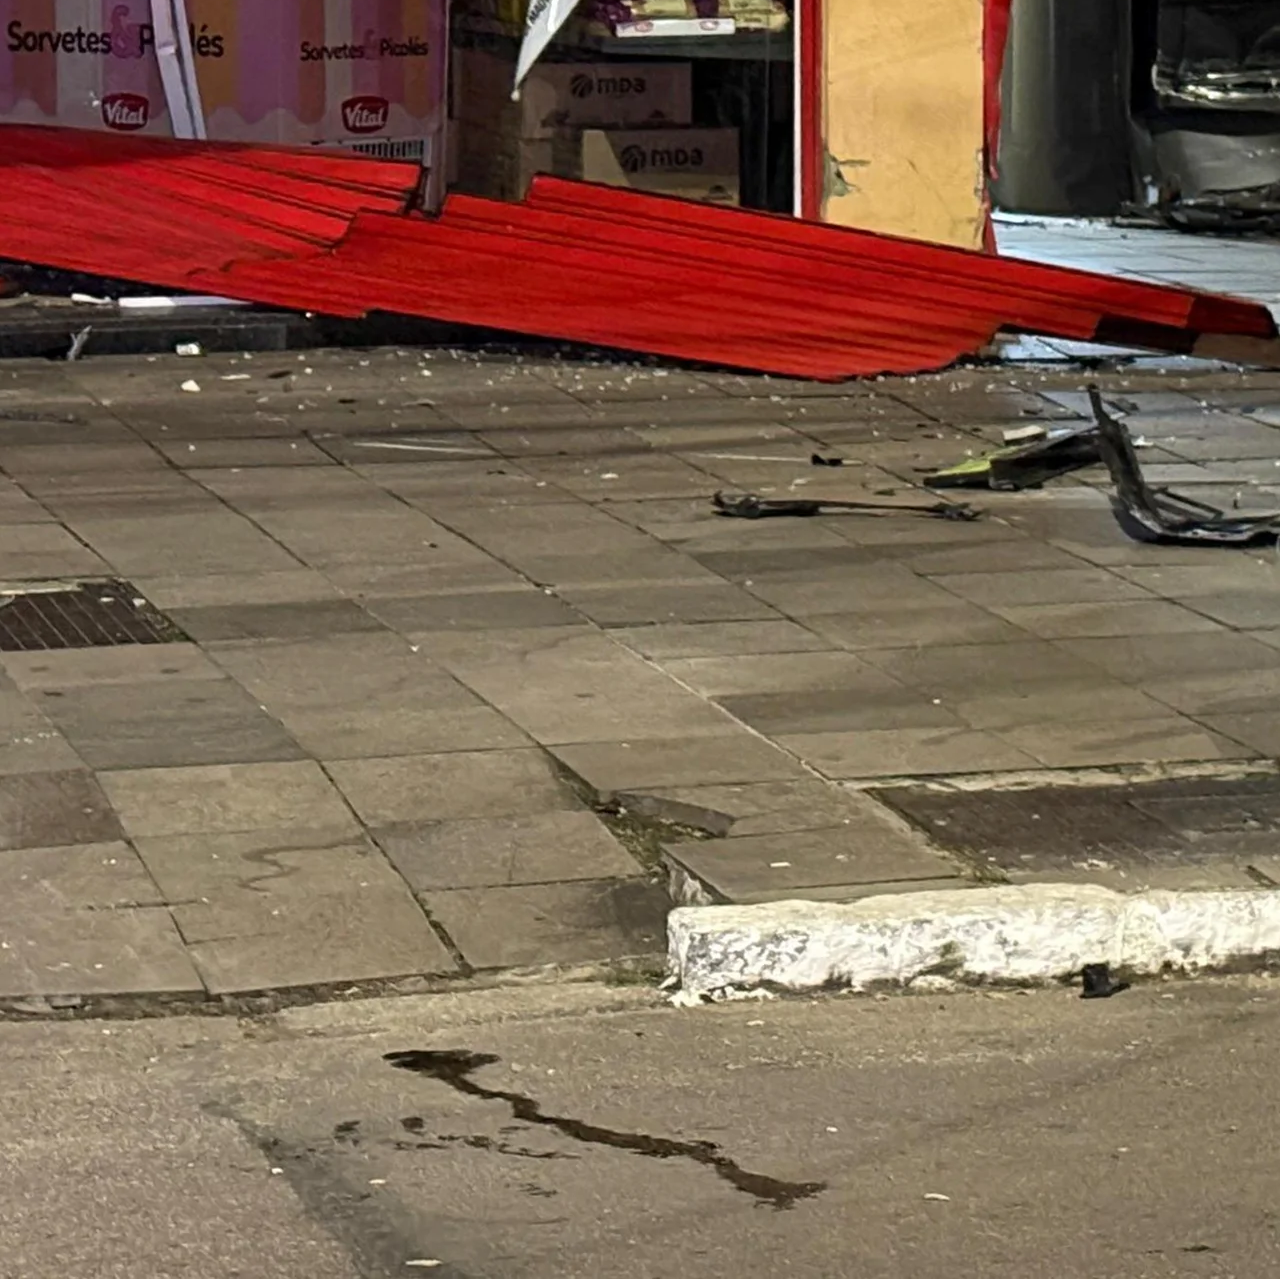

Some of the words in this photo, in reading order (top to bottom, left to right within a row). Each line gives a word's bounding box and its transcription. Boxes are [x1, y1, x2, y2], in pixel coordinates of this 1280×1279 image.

[6, 19, 113, 54] Sorvetes
[300, 40, 365, 62] Sorvetes
[105, 99, 146, 126] Vital
[345, 102, 386, 128] Vital
